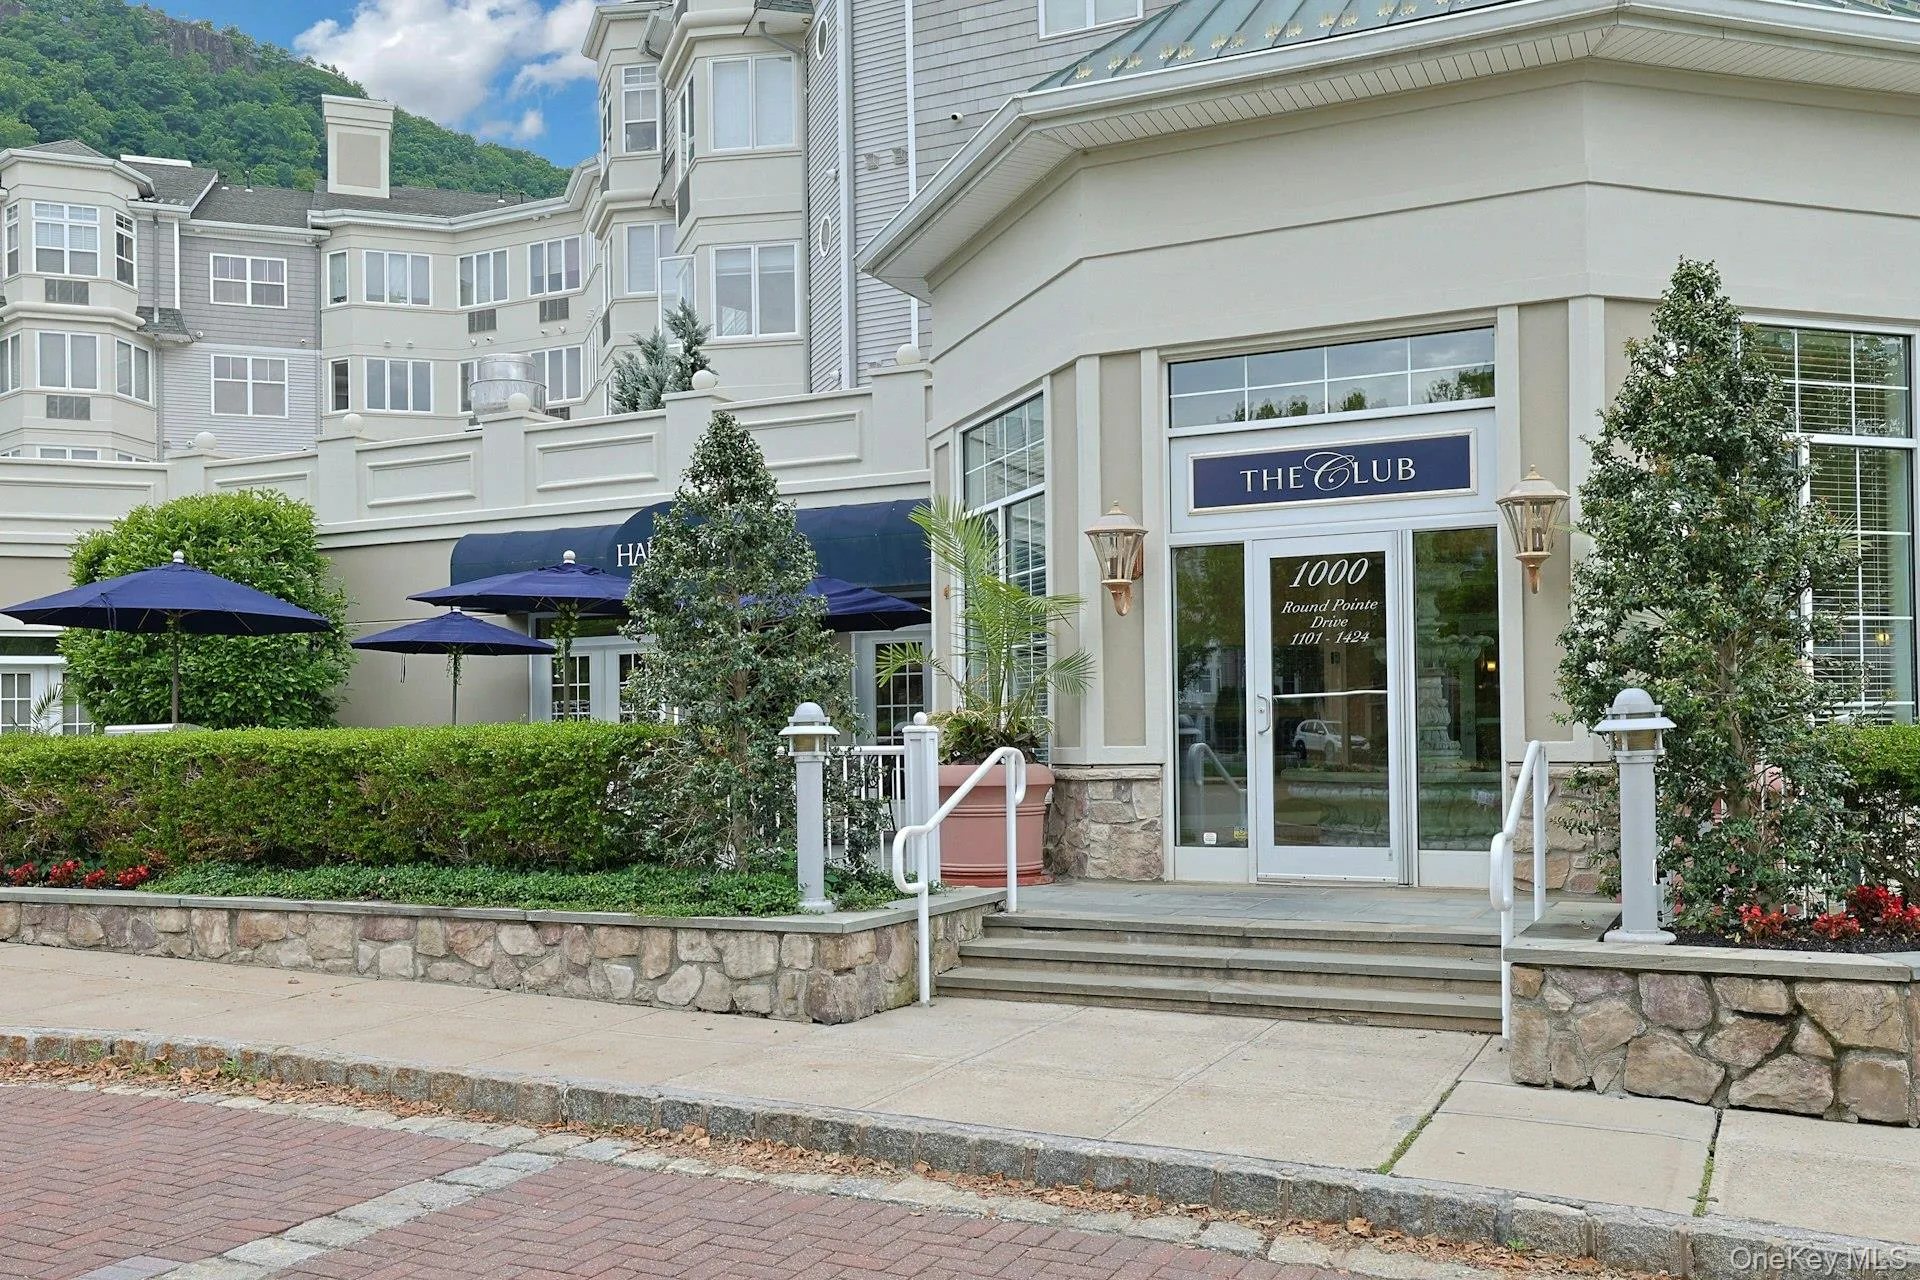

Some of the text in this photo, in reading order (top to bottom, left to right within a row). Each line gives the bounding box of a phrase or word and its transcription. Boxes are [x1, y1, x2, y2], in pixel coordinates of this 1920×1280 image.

[1239, 451, 1417, 493] THE CLUB
[616, 541, 652, 567] HA
[1288, 557, 1369, 588] 1000
[1281, 597, 1378, 614] Round Pointe
[1310, 615, 1349, 629] Drive
[1290, 631, 1323, 646] 1101
[1334, 630, 1370, 644] 1424
